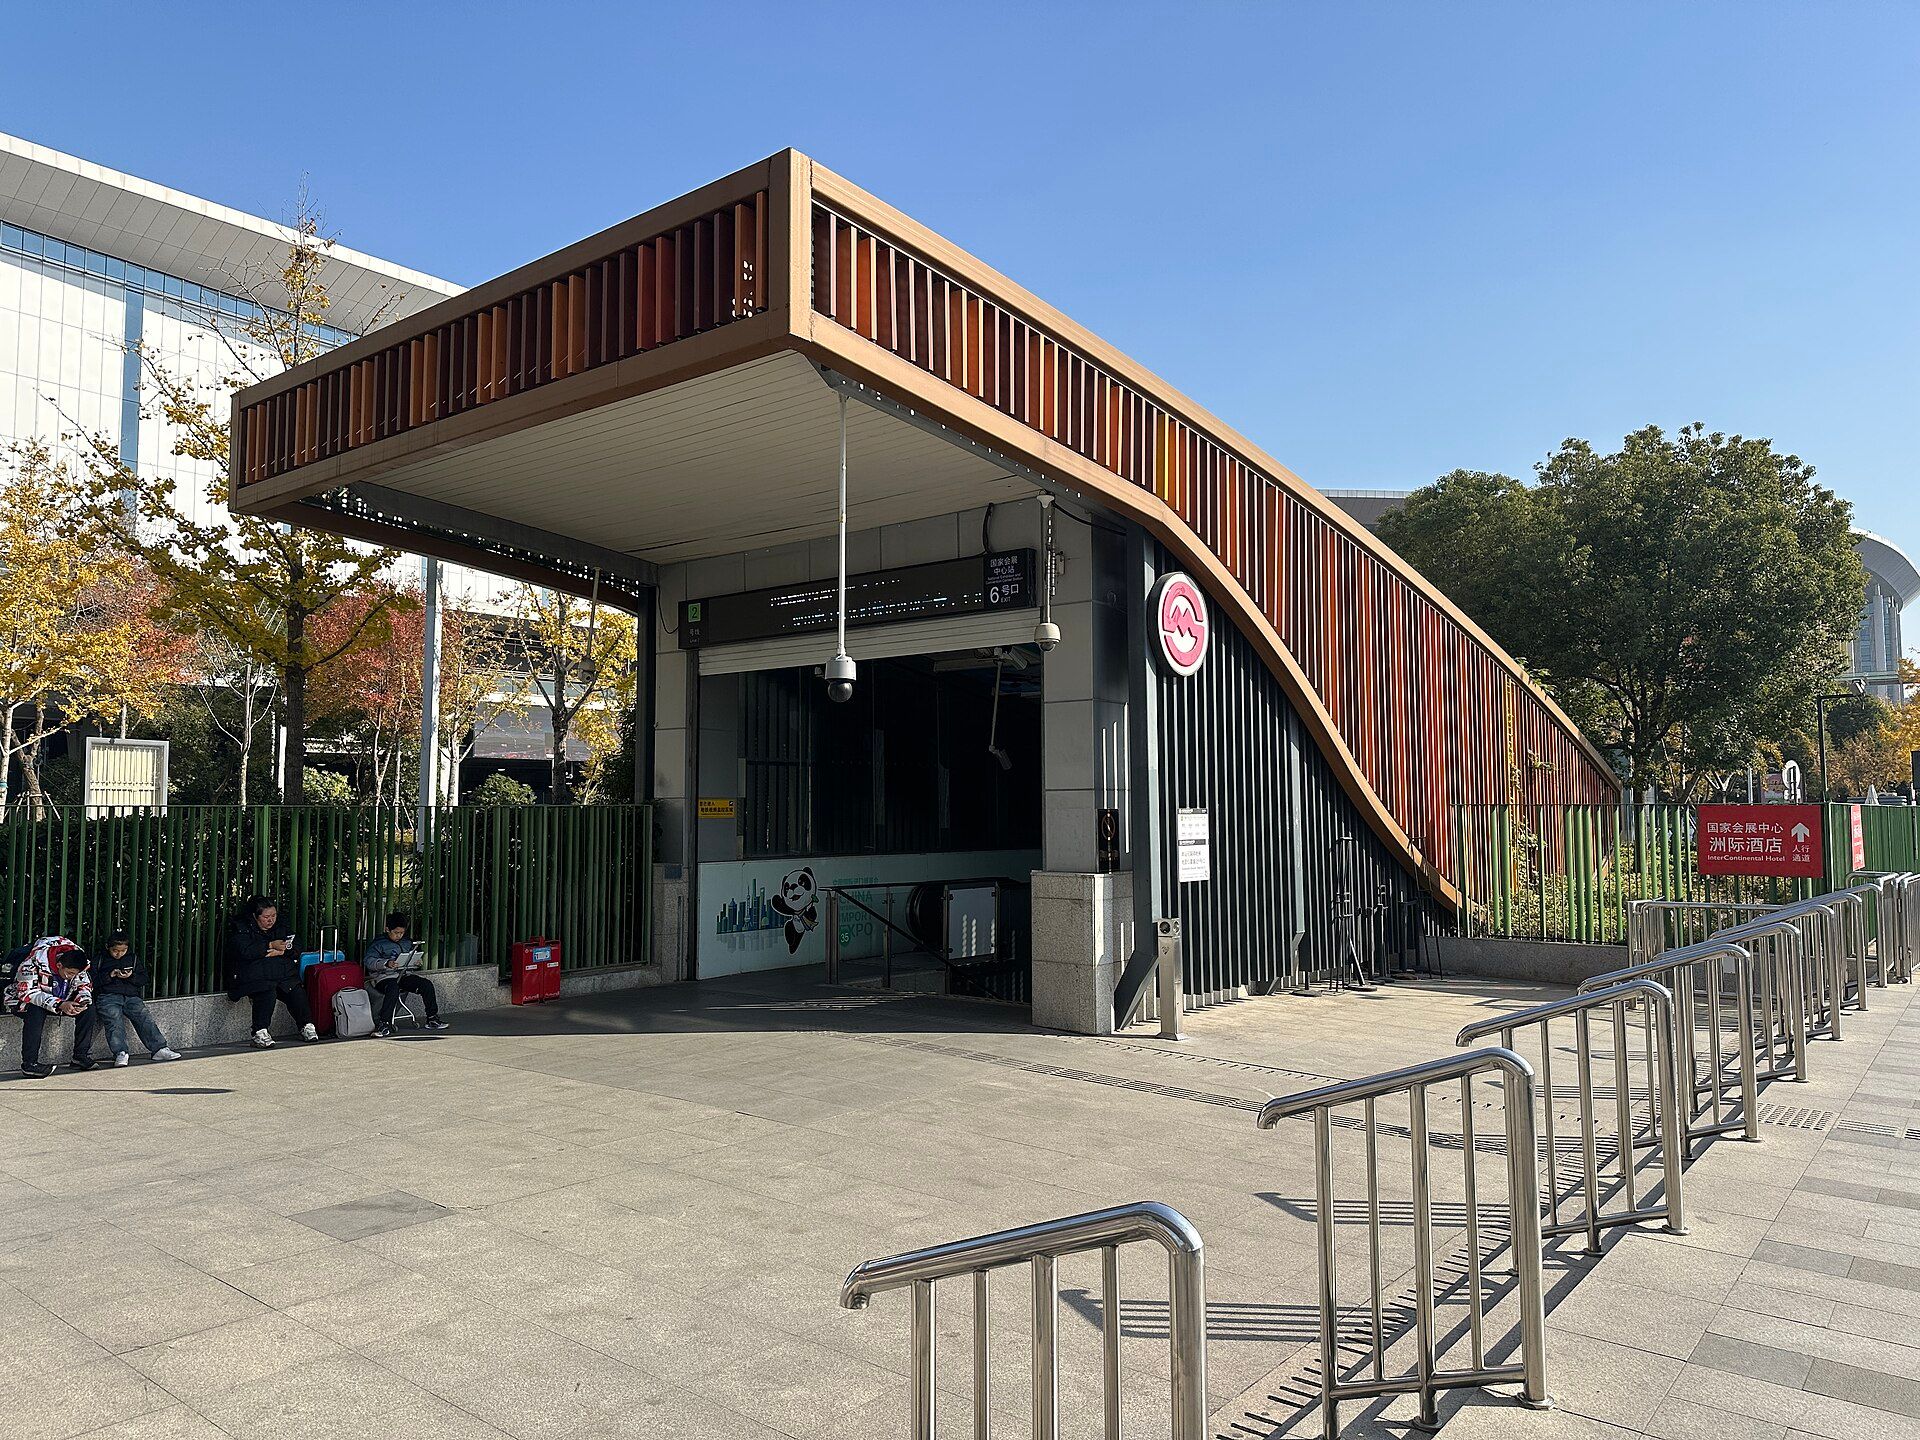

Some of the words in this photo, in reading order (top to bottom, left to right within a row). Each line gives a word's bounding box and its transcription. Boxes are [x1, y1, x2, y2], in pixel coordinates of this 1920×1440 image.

[990, 555, 1018, 567] 国家会展
[993, 566, 1015, 575] 中心站
[990, 586, 999, 603] 6
[1001, 583, 1019, 596] 号口
[1707, 822, 1784, 834] 国家会展中心
[1709, 836, 1783, 853] 洲际酒店
[1792, 844, 1810, 853] 人行
[1792, 853, 1811, 863] 通道
